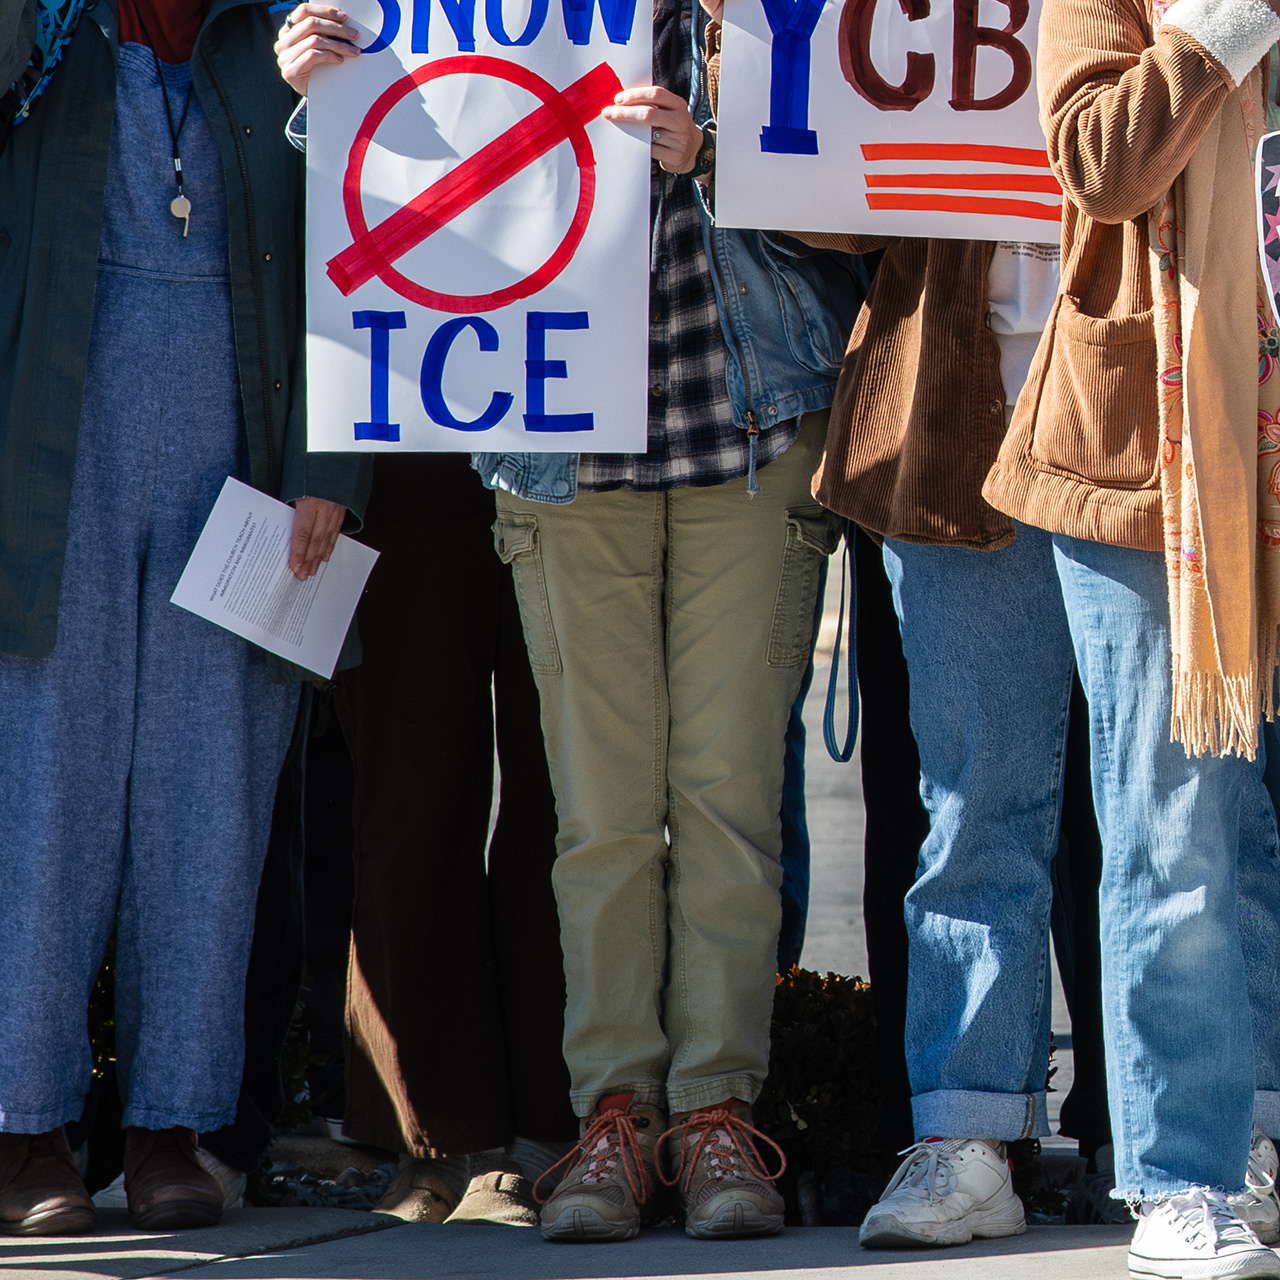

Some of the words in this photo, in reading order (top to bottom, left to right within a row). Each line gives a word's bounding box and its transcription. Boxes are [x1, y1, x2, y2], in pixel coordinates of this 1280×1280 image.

[352, 310, 594, 442] ICE
[209, 587, 218, 602] WHAT
[216, 573, 226, 588] DOES
[222, 562, 230, 574] THE
[227, 543, 239, 564] CHURCH
[235, 528, 247, 544] TEACH
[234, 553, 243, 567] AND
